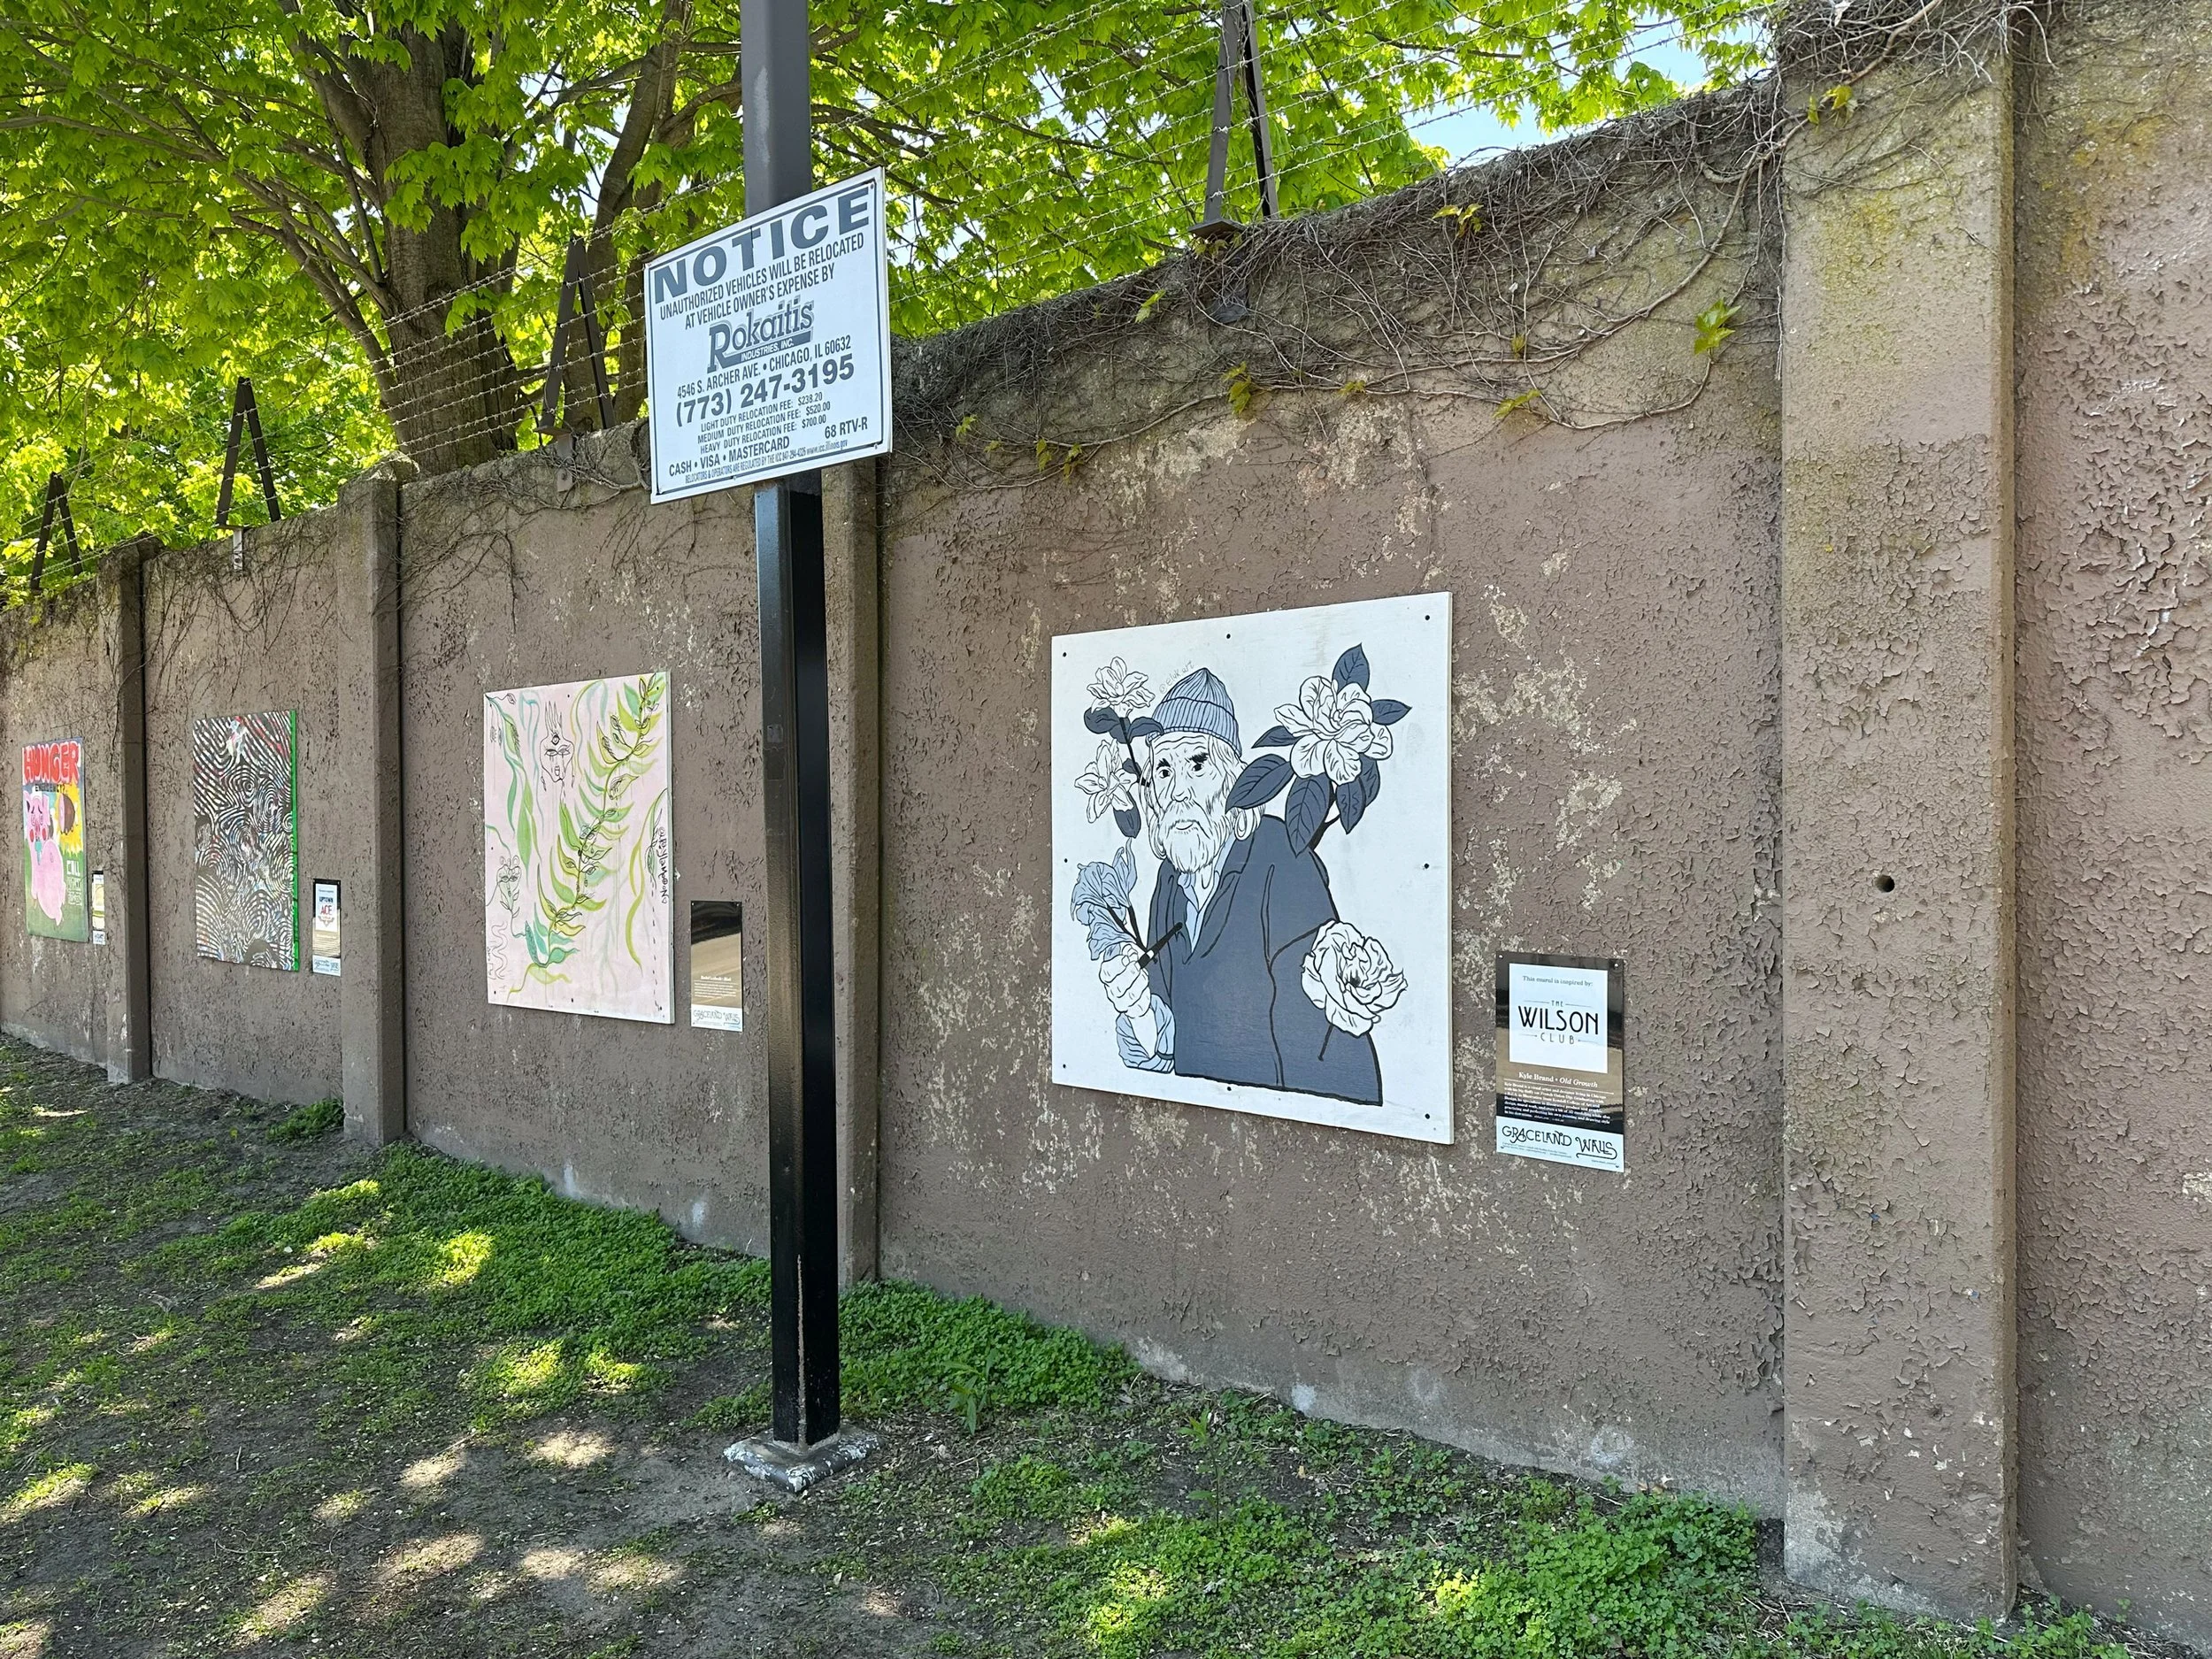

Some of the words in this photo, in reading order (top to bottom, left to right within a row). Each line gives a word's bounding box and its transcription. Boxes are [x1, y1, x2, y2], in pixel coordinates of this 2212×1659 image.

[654, 187, 869, 304] NOTICE
[660, 284, 724, 320] UNAUTHORIZED
[726, 268, 767, 297] VEHICLES
[769, 258, 792, 280] WILL
[794, 253, 806, 273] BE
[809, 232, 864, 267] RELOCATED
[685, 312, 695, 330] AT
[697, 300, 731, 326] VEHICLE
[733, 284, 774, 313] OWNER'S
[777, 268, 819, 298] EXPENSE
[822, 262, 834, 282] BY
[707, 296, 813, 373] Rokaitis
[780, 338, 794, 349] INC.
[677, 382, 695, 399] 4546
[697, 380, 704, 394] S.
[707, 368, 740, 391] ARCHER
[742, 362, 761, 380] AVE.
[769, 347, 812, 372] CHICAGO,
[815, 342, 823, 358] IL
[825, 334, 851, 356] 60632
[676, 388, 732, 427] (773)
[741, 353, 855, 409] 247-3195
[697, 429, 724, 444] MEDIUM
[727, 424, 744, 436] DUTY
[746, 411, 786, 432] RELOCATION
[787, 409, 801, 420] FEE:
[806, 401, 831, 416] $520.00
[701, 419, 718, 433] LIGHT
[720, 414, 737, 427] DUTY
[738, 403, 778, 423] RELOCATION
[780, 399, 793, 411] FEE:
[798, 391, 823, 406] $238.20
[825, 425, 837, 439] 68
[840, 417, 868, 436] RTV-R
[700, 442, 720, 455] HEAVY
[724, 436, 741, 449] DUTY
[742, 425, 781, 444] RELOCATION
[783, 421, 797, 434] FEE:
[802, 414, 826, 429] $700.00
[669, 459, 692, 477] CASH
[700, 453, 720, 469] VISA
[728, 435, 790, 463] MASTERCARD
[685, 470, 707, 484] RELOCATORS
[708, 470, 711, 479] &
[711, 464, 733, 478] OPERATORS
[741, 457, 761, 471] REGULATED
[761, 456, 766, 465] BY
[22, 741, 81, 786] HUNGER
[320, 904, 333, 915] ACE
[1518, 1005, 1599, 1035] WILSON
[1540, 1033, 1574, 1044] CLUB
[1518, 1071, 1532, 1080] Kyle
[1533, 1073, 1554, 1082] Brand
[1573, 1079, 1598, 1088] Growth
[1502, 1125, 1572, 1146] GRACELAND
[1575, 1136, 1617, 1160] WALLS
